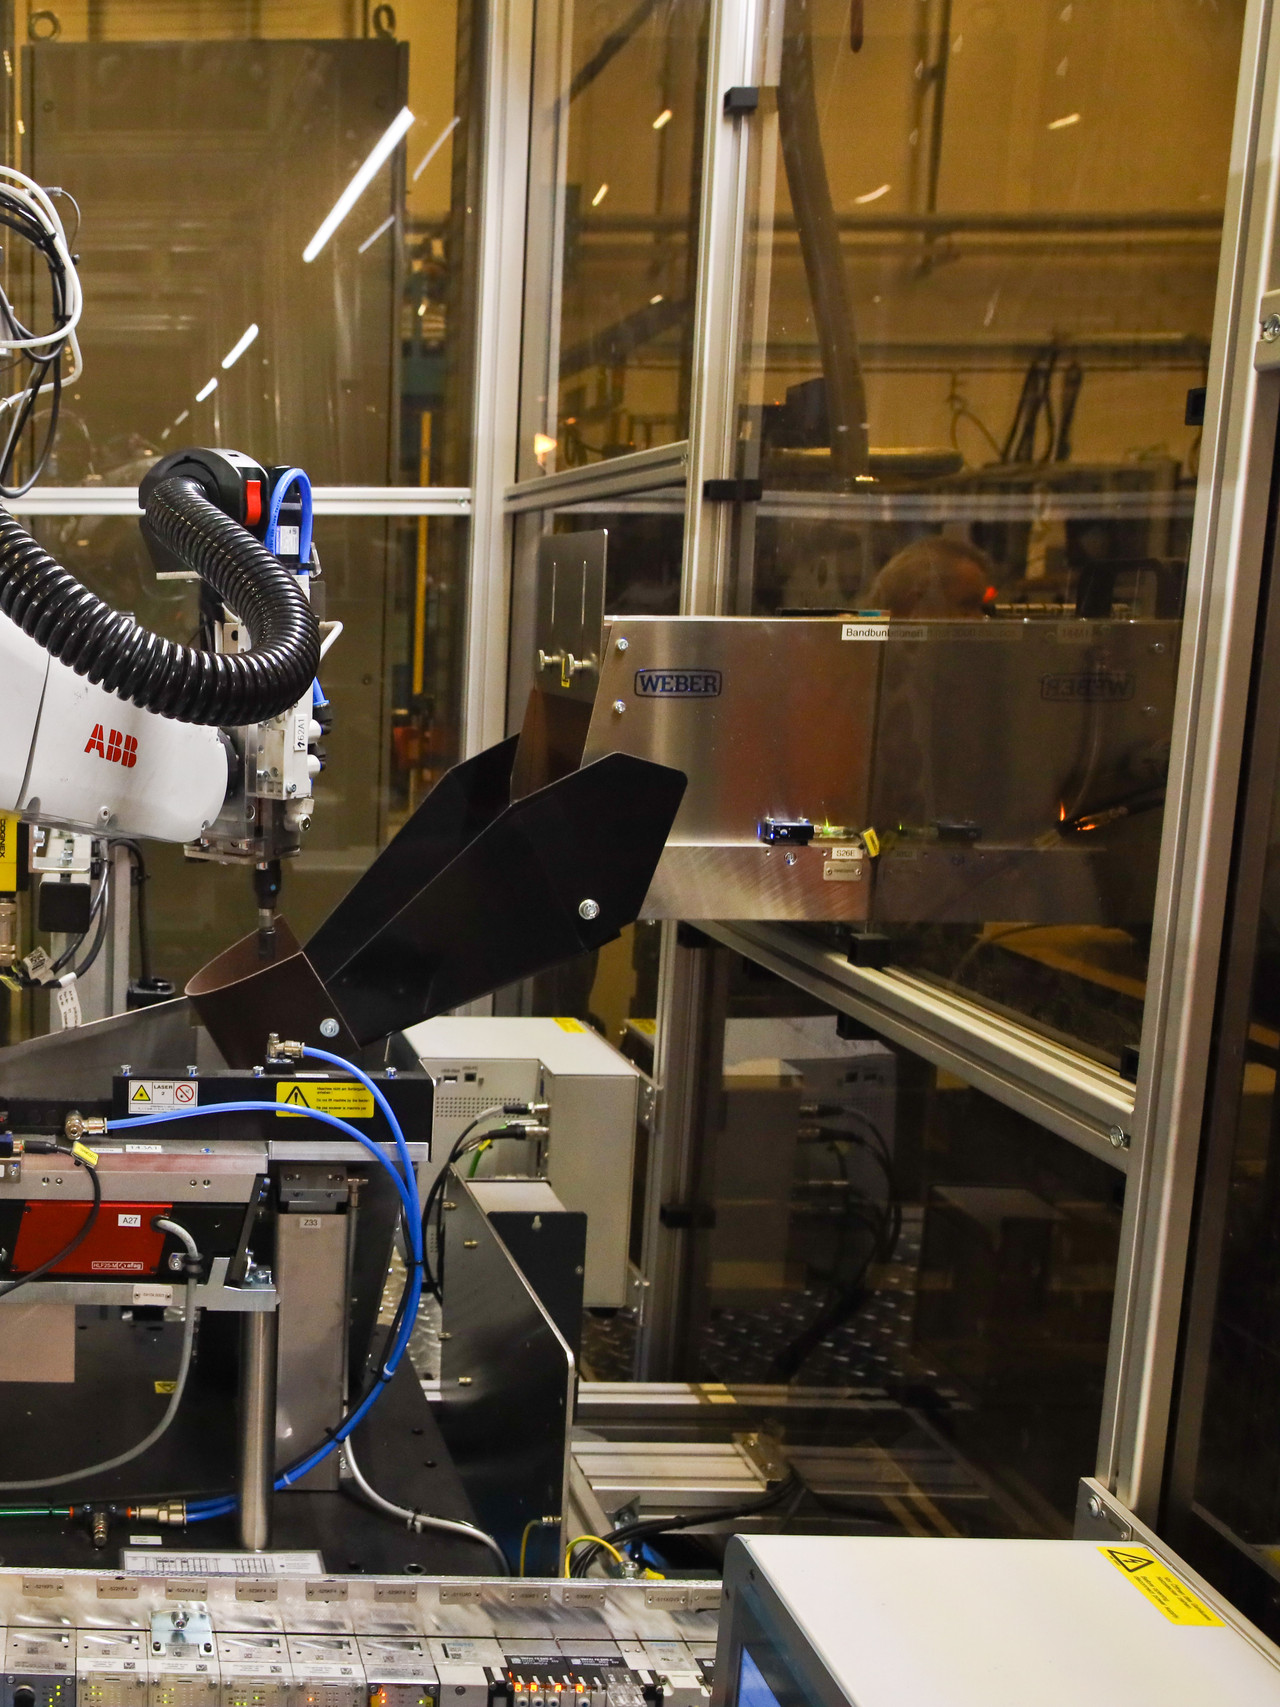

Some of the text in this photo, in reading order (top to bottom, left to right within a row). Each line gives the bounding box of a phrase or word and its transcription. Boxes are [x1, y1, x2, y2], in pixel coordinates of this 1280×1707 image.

[846, 628, 889, 637] Bandbun
[638, 674, 718, 693] WEBER
[84, 723, 138, 768] ABB
